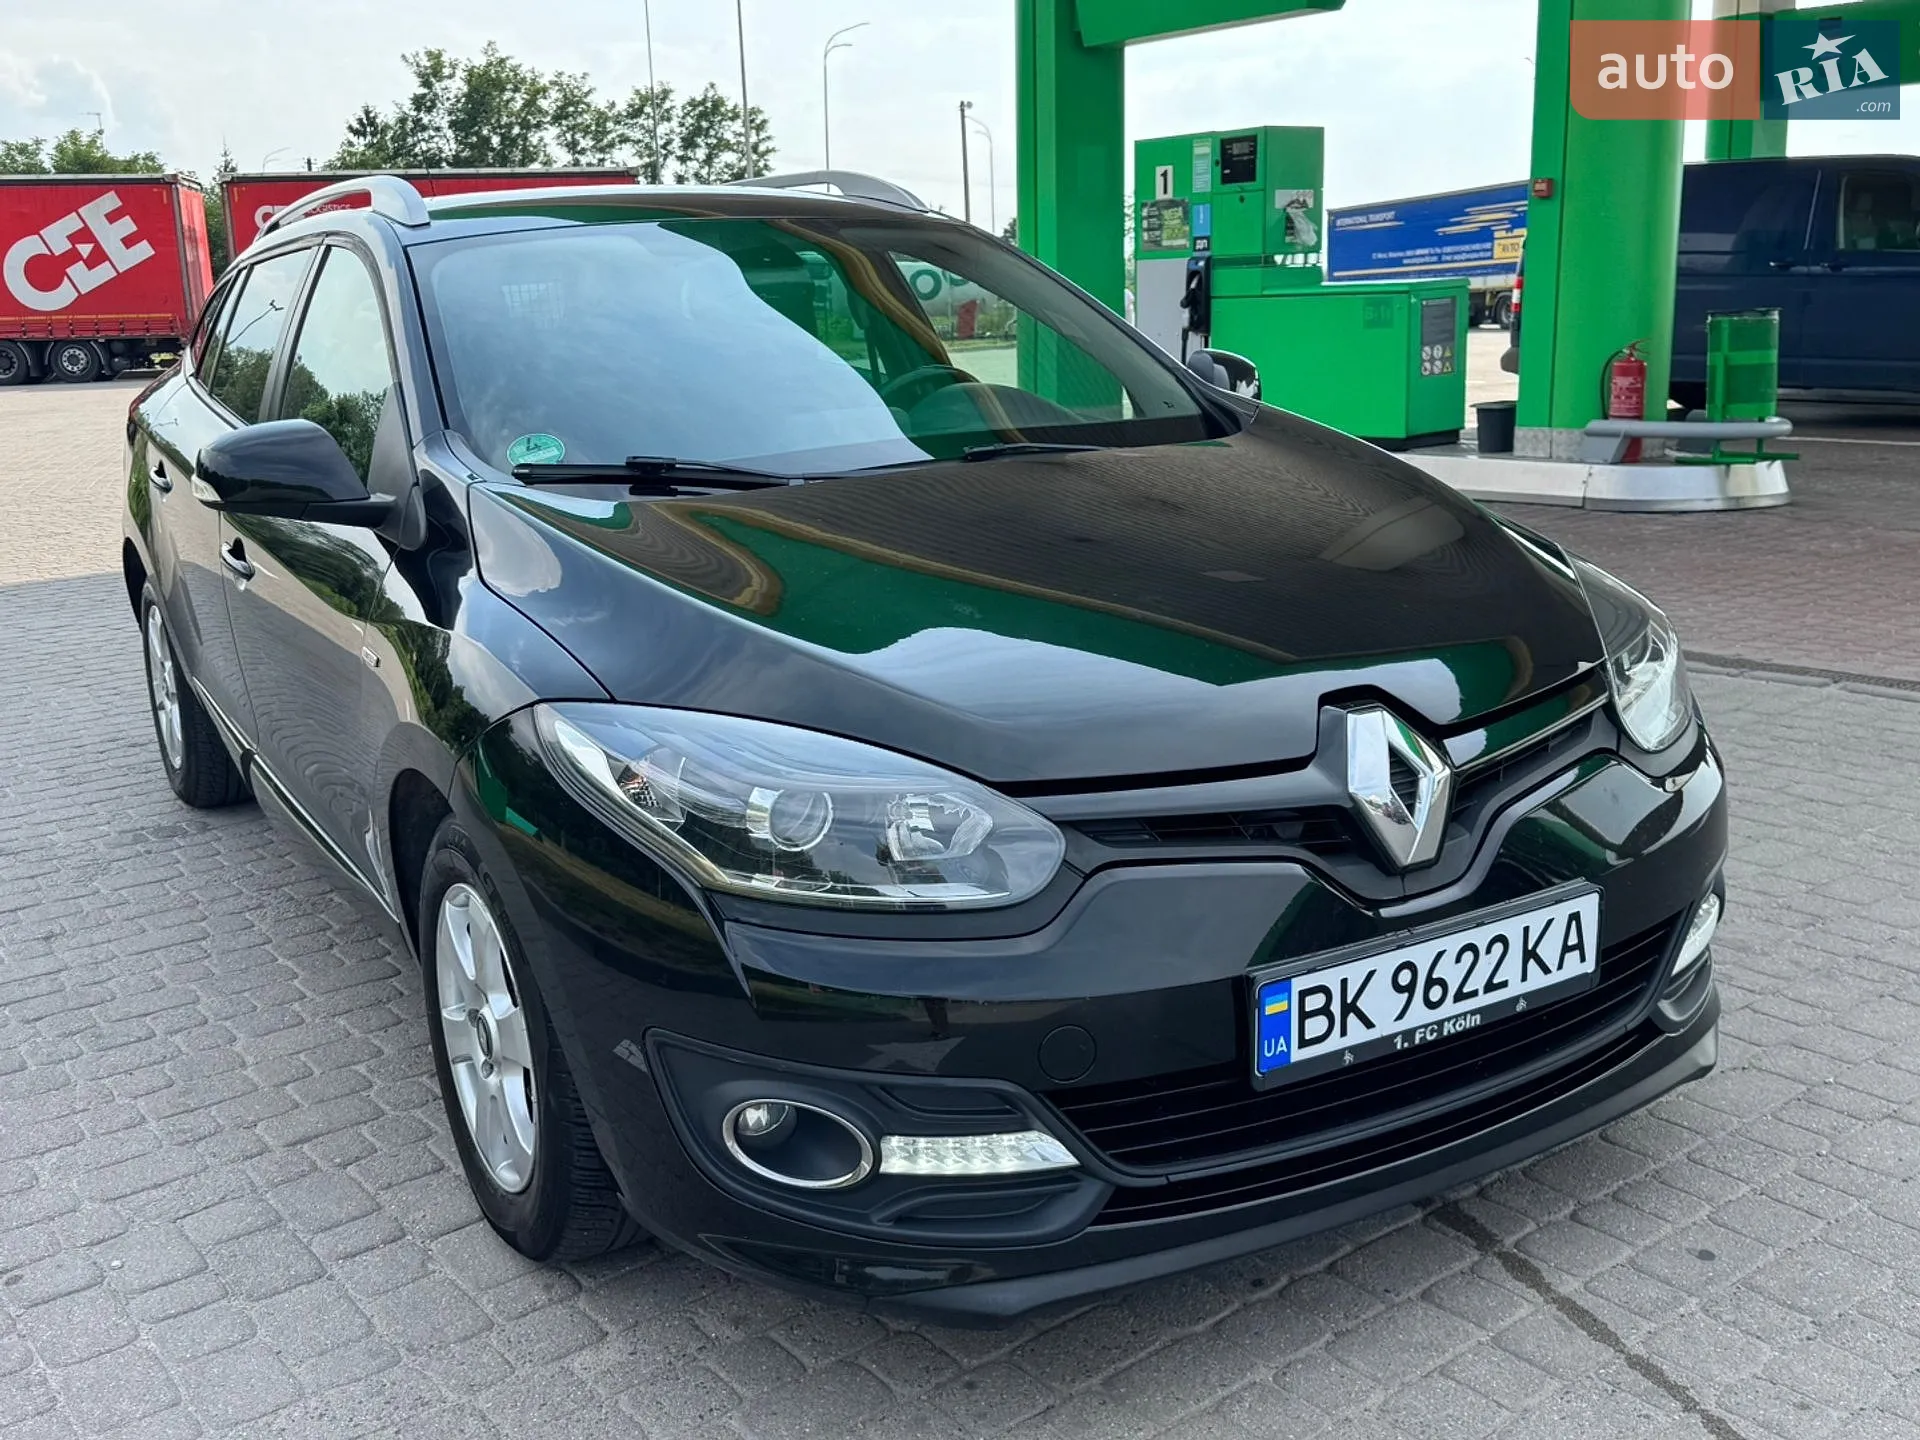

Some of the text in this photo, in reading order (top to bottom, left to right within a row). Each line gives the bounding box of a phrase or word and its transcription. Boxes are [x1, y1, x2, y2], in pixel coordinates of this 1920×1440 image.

[1160, 169, 1168, 195] 1
[1297, 910, 1587, 1051] BK 9622 KA
[1264, 1035, 1288, 1058] UA
[1394, 1012, 1482, 1050] 1. FC Köln
